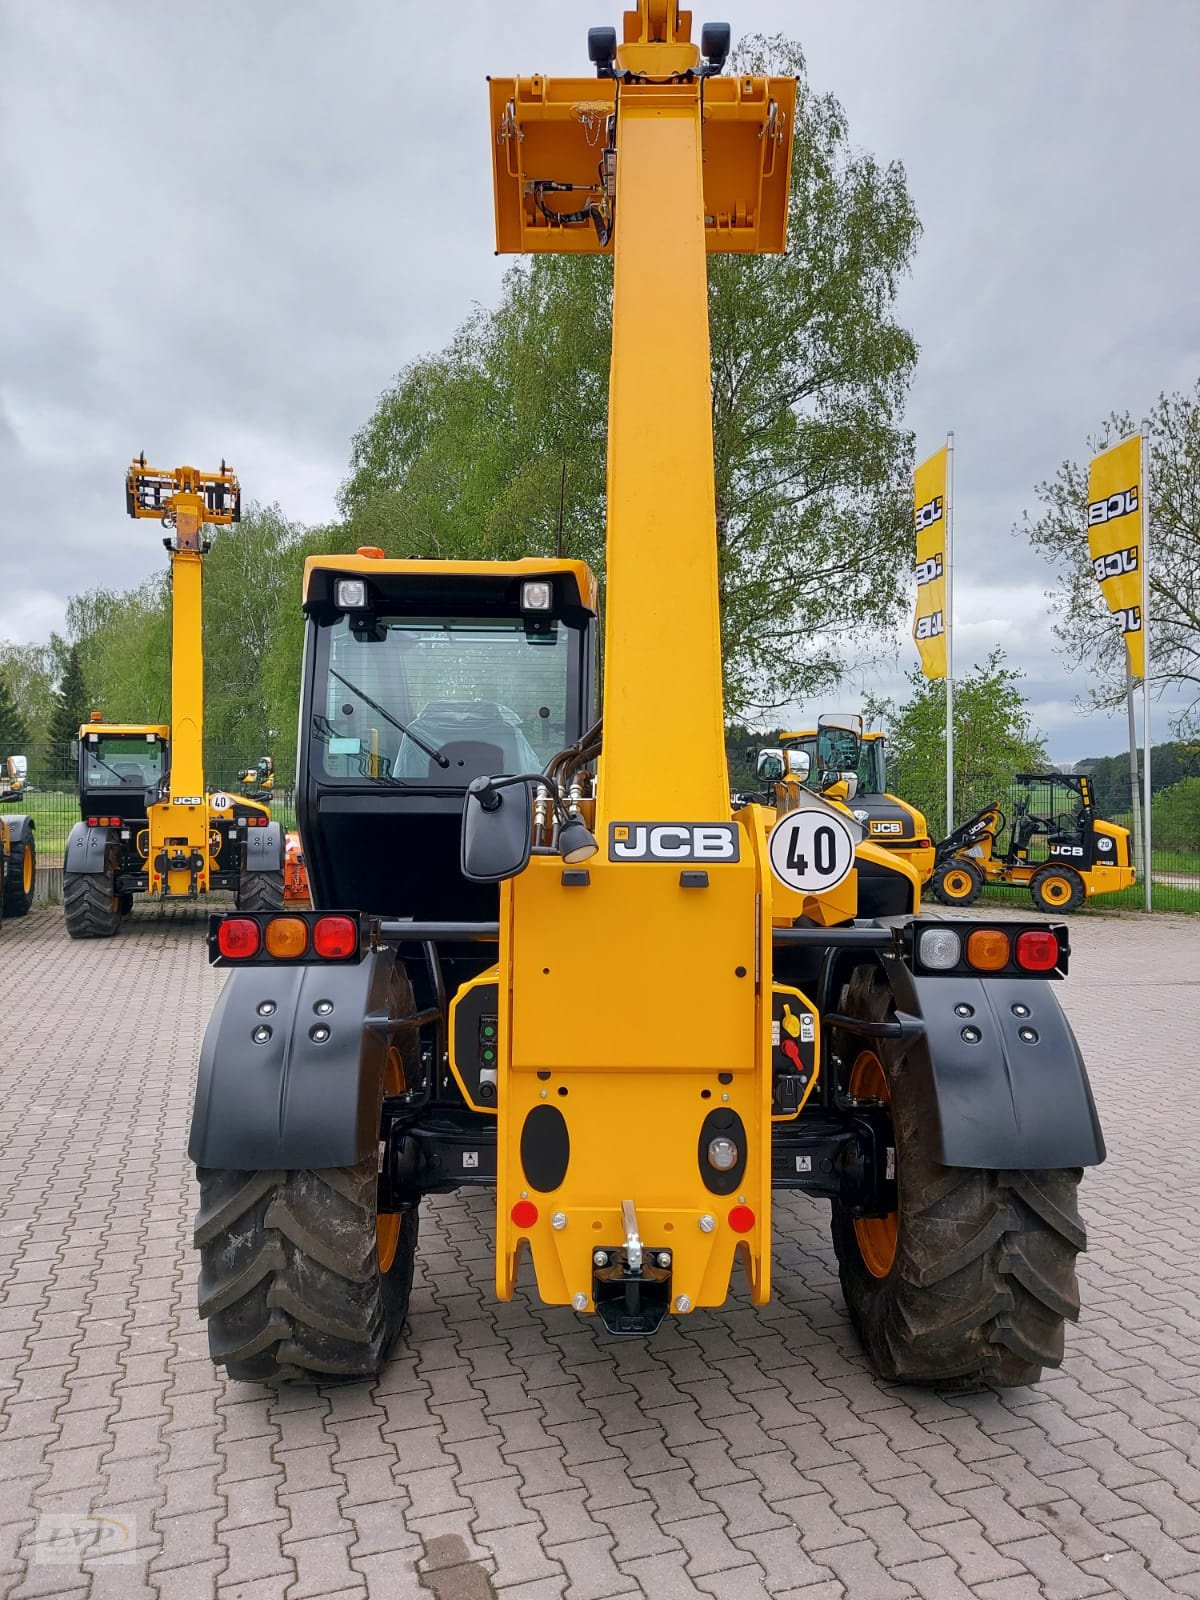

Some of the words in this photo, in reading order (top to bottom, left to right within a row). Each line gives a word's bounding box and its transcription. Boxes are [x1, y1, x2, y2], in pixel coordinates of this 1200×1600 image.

[215, 797, 226, 808] 40
[872, 823, 900, 833] JCB
[969, 821, 986, 835] JCB
[614, 826, 734, 858] JCB
[786, 825, 837, 876] 40
[1051, 845, 1084, 856] JCB
